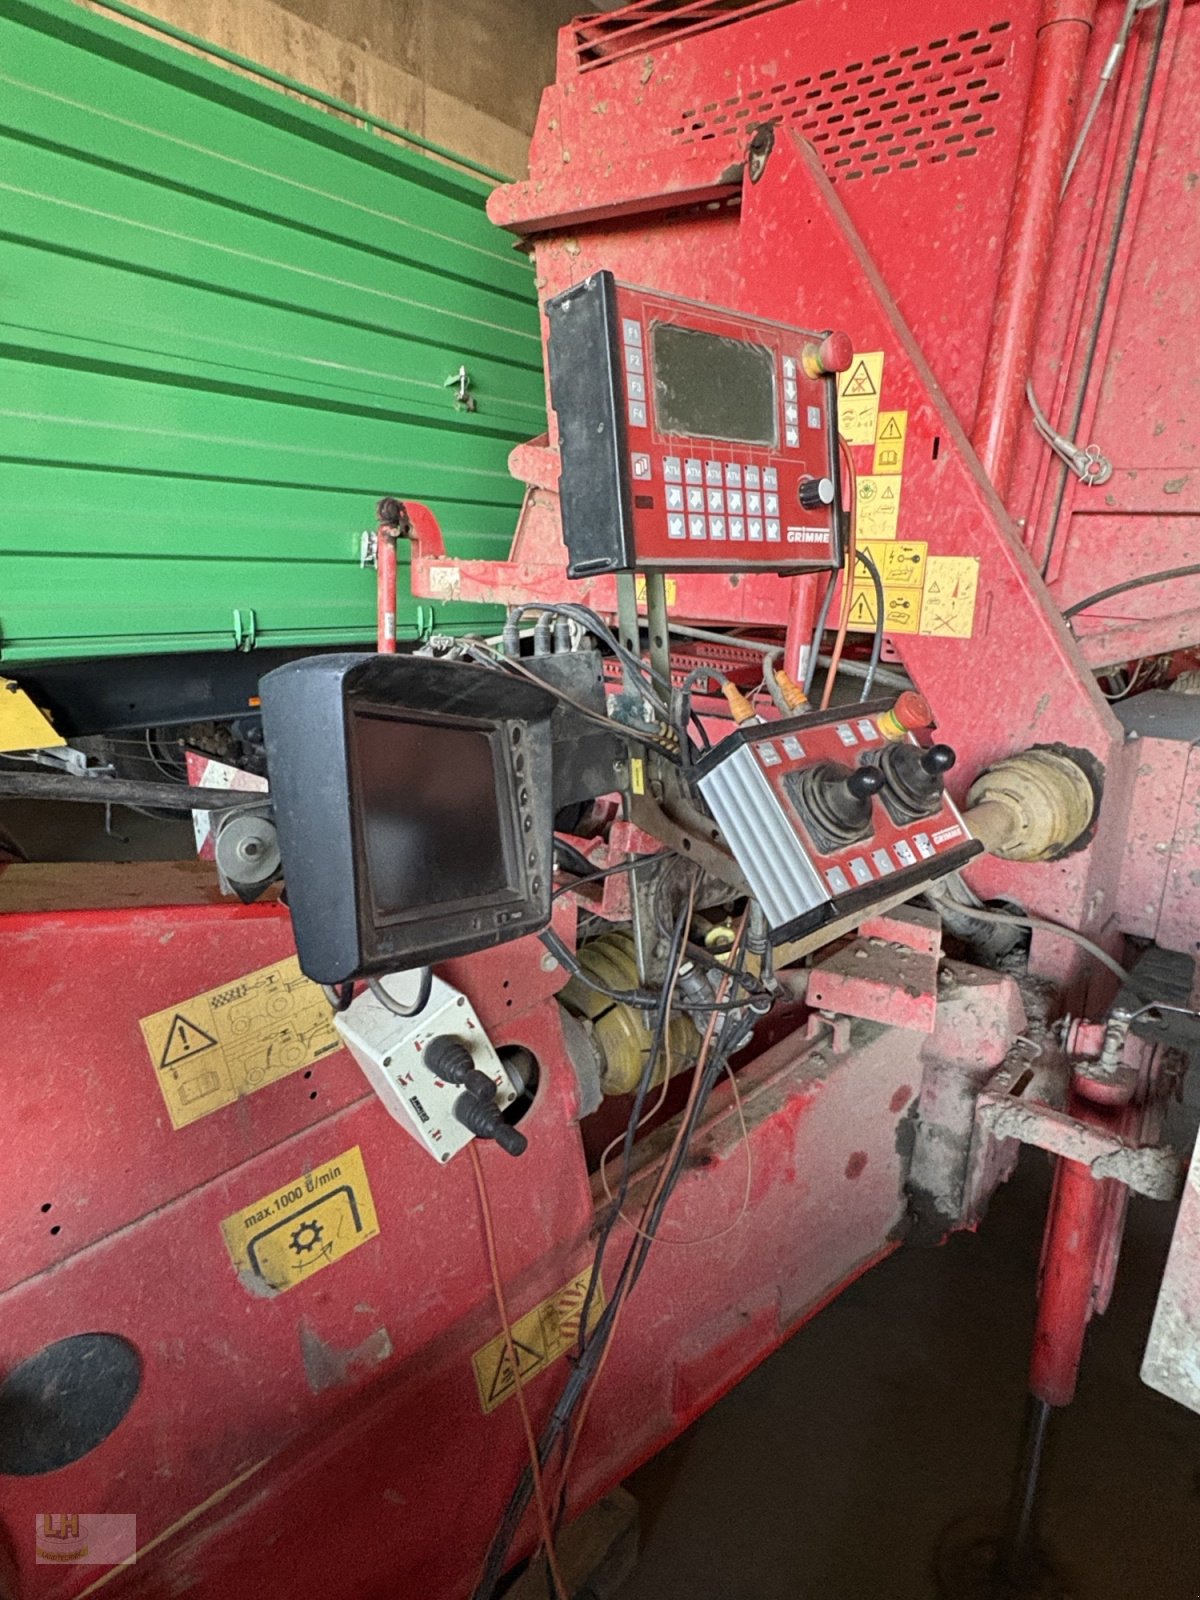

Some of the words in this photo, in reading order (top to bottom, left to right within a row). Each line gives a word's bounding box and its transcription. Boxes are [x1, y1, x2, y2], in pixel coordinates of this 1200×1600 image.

[628, 327, 638, 339] F1
[630, 354, 640, 366] F2
[631, 381, 642, 393] F3
[633, 408, 643, 419] F4
[787, 526, 830, 544] GRIMME
